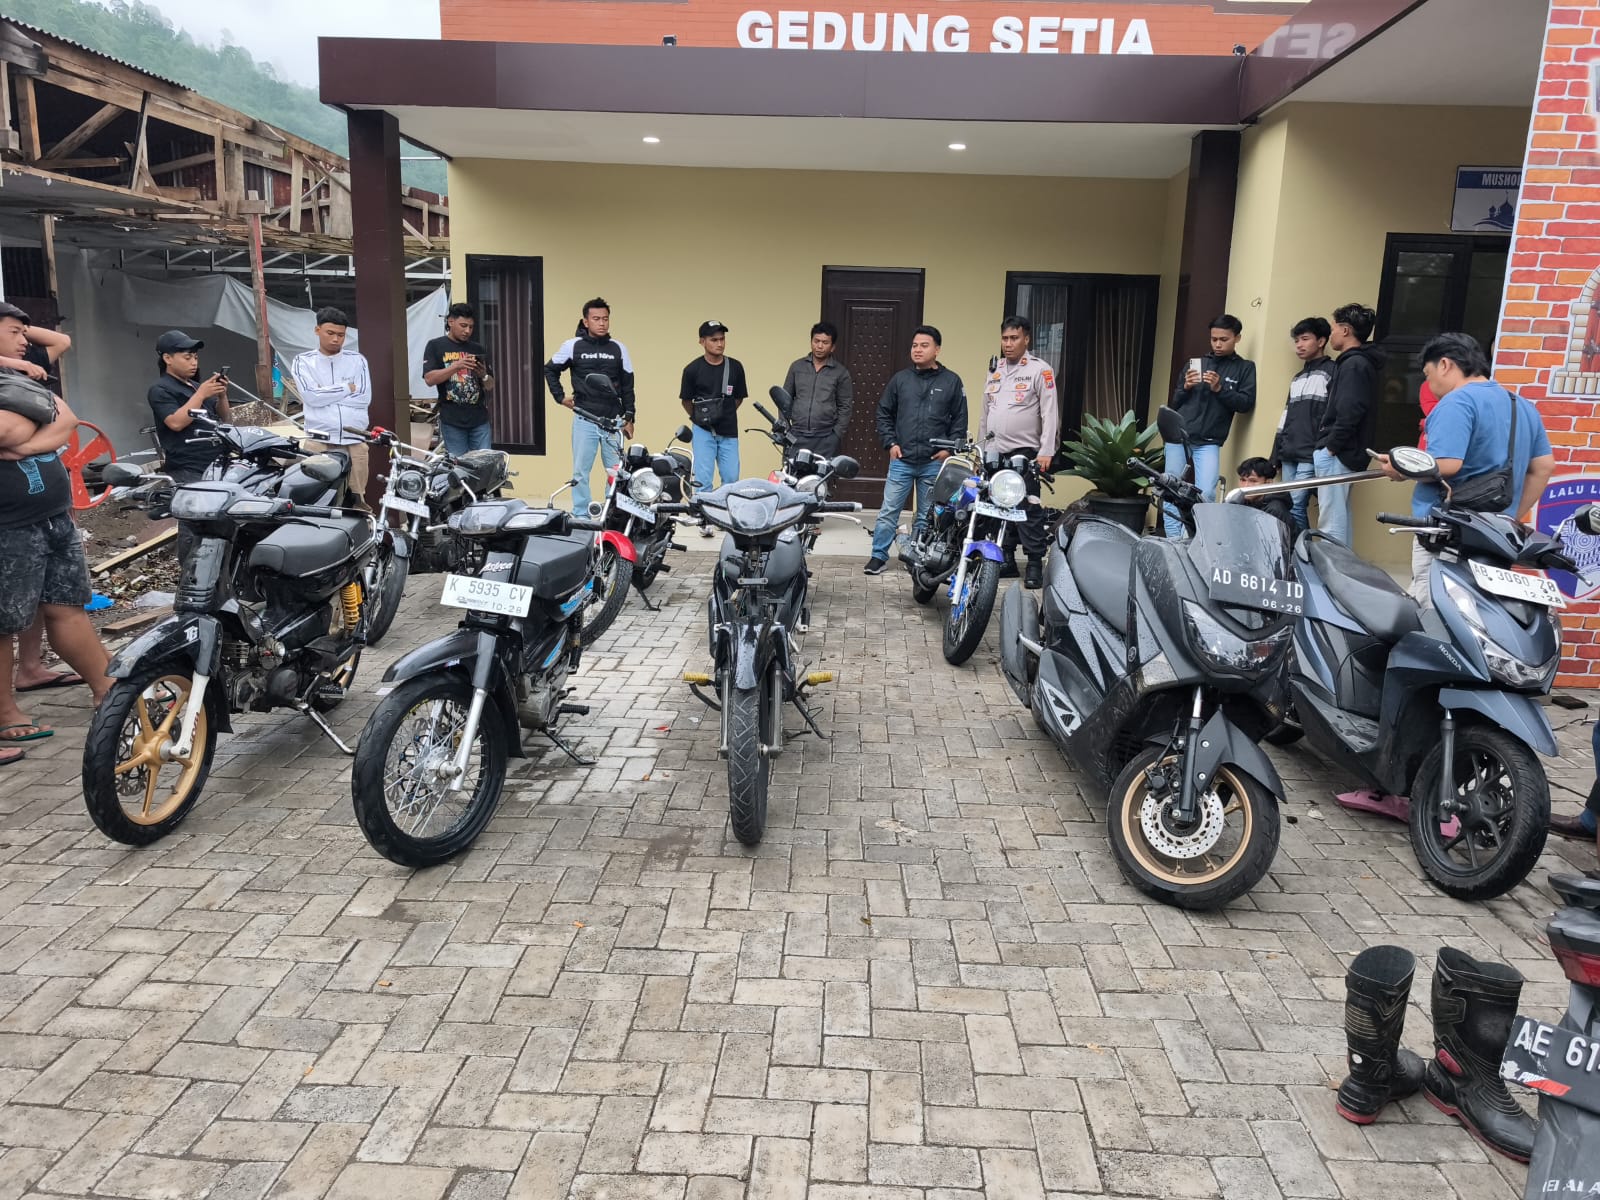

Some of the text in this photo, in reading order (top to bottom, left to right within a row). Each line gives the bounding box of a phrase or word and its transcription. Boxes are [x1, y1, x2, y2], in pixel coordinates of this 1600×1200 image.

[736, 10, 1154, 55] GEDUNG SETIA
[1549, 485, 1584, 499] LALU
[1213, 568, 1304, 599] AD 6614 ID
[1473, 563, 1489, 577] AB
[1495, 569, 1530, 587] 3060
[449, 577, 527, 602] K 5935 CV
[1438, 644, 1462, 671] HONDA
[1513, 1020, 1600, 1072] AE 61
